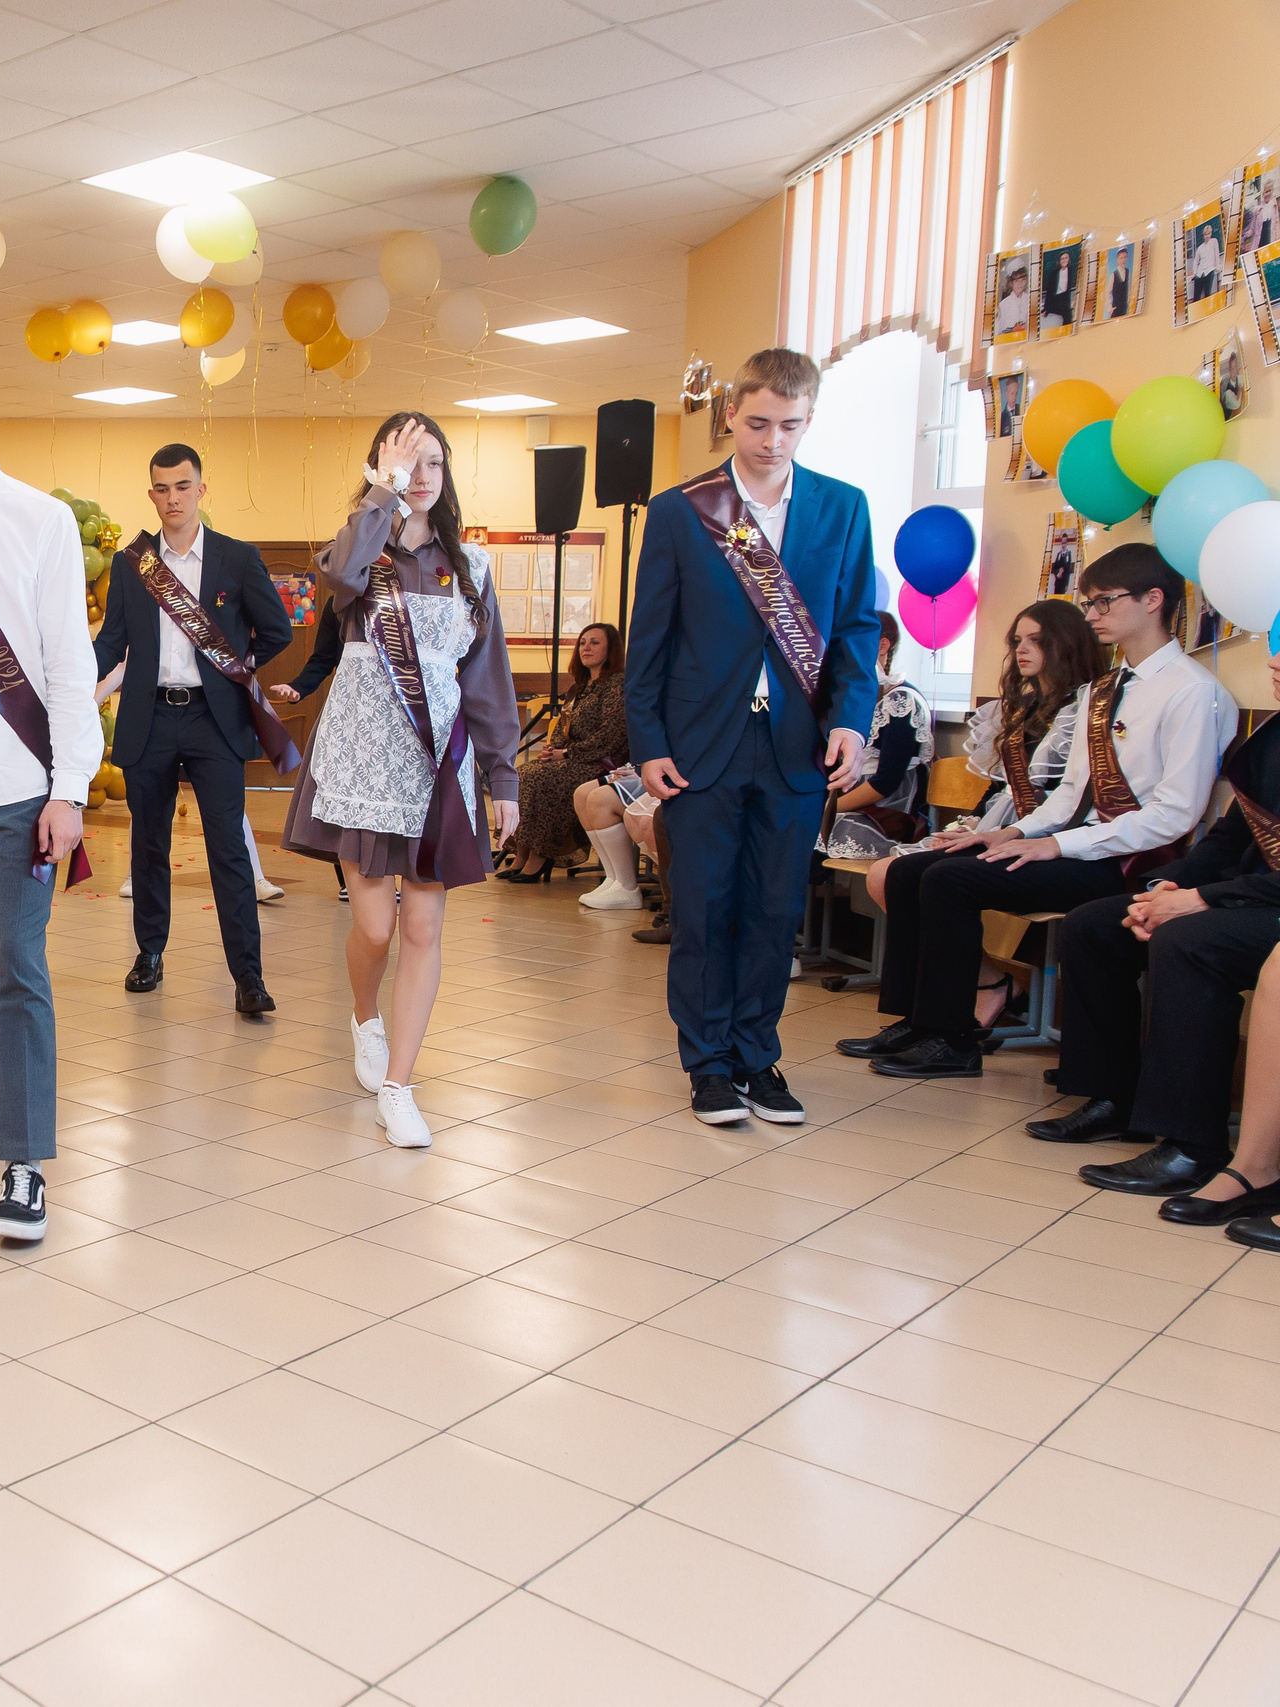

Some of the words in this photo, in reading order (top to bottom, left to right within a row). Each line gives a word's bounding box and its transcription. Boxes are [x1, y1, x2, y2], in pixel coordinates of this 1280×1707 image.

[518, 534, 556, 542] АТТЕСТАЦ
[151, 569, 212, 643] Выпускник
[206, 636, 237, 667] 2024
[368, 552, 403, 663] Выпускница
[388, 664, 422, 706] 2024
[743, 549, 815, 661] Выпускник
[778, 579, 800, 604] Егоров
[793, 605, 815, 637] Никита
[767, 615, 779, 636] Школа
[791, 658, 812, 694] Кронштадт
[1008, 723, 1039, 809] Выпускница
[1089, 690, 1112, 776] Выпускник
[1099, 774, 1137, 811] 2024
